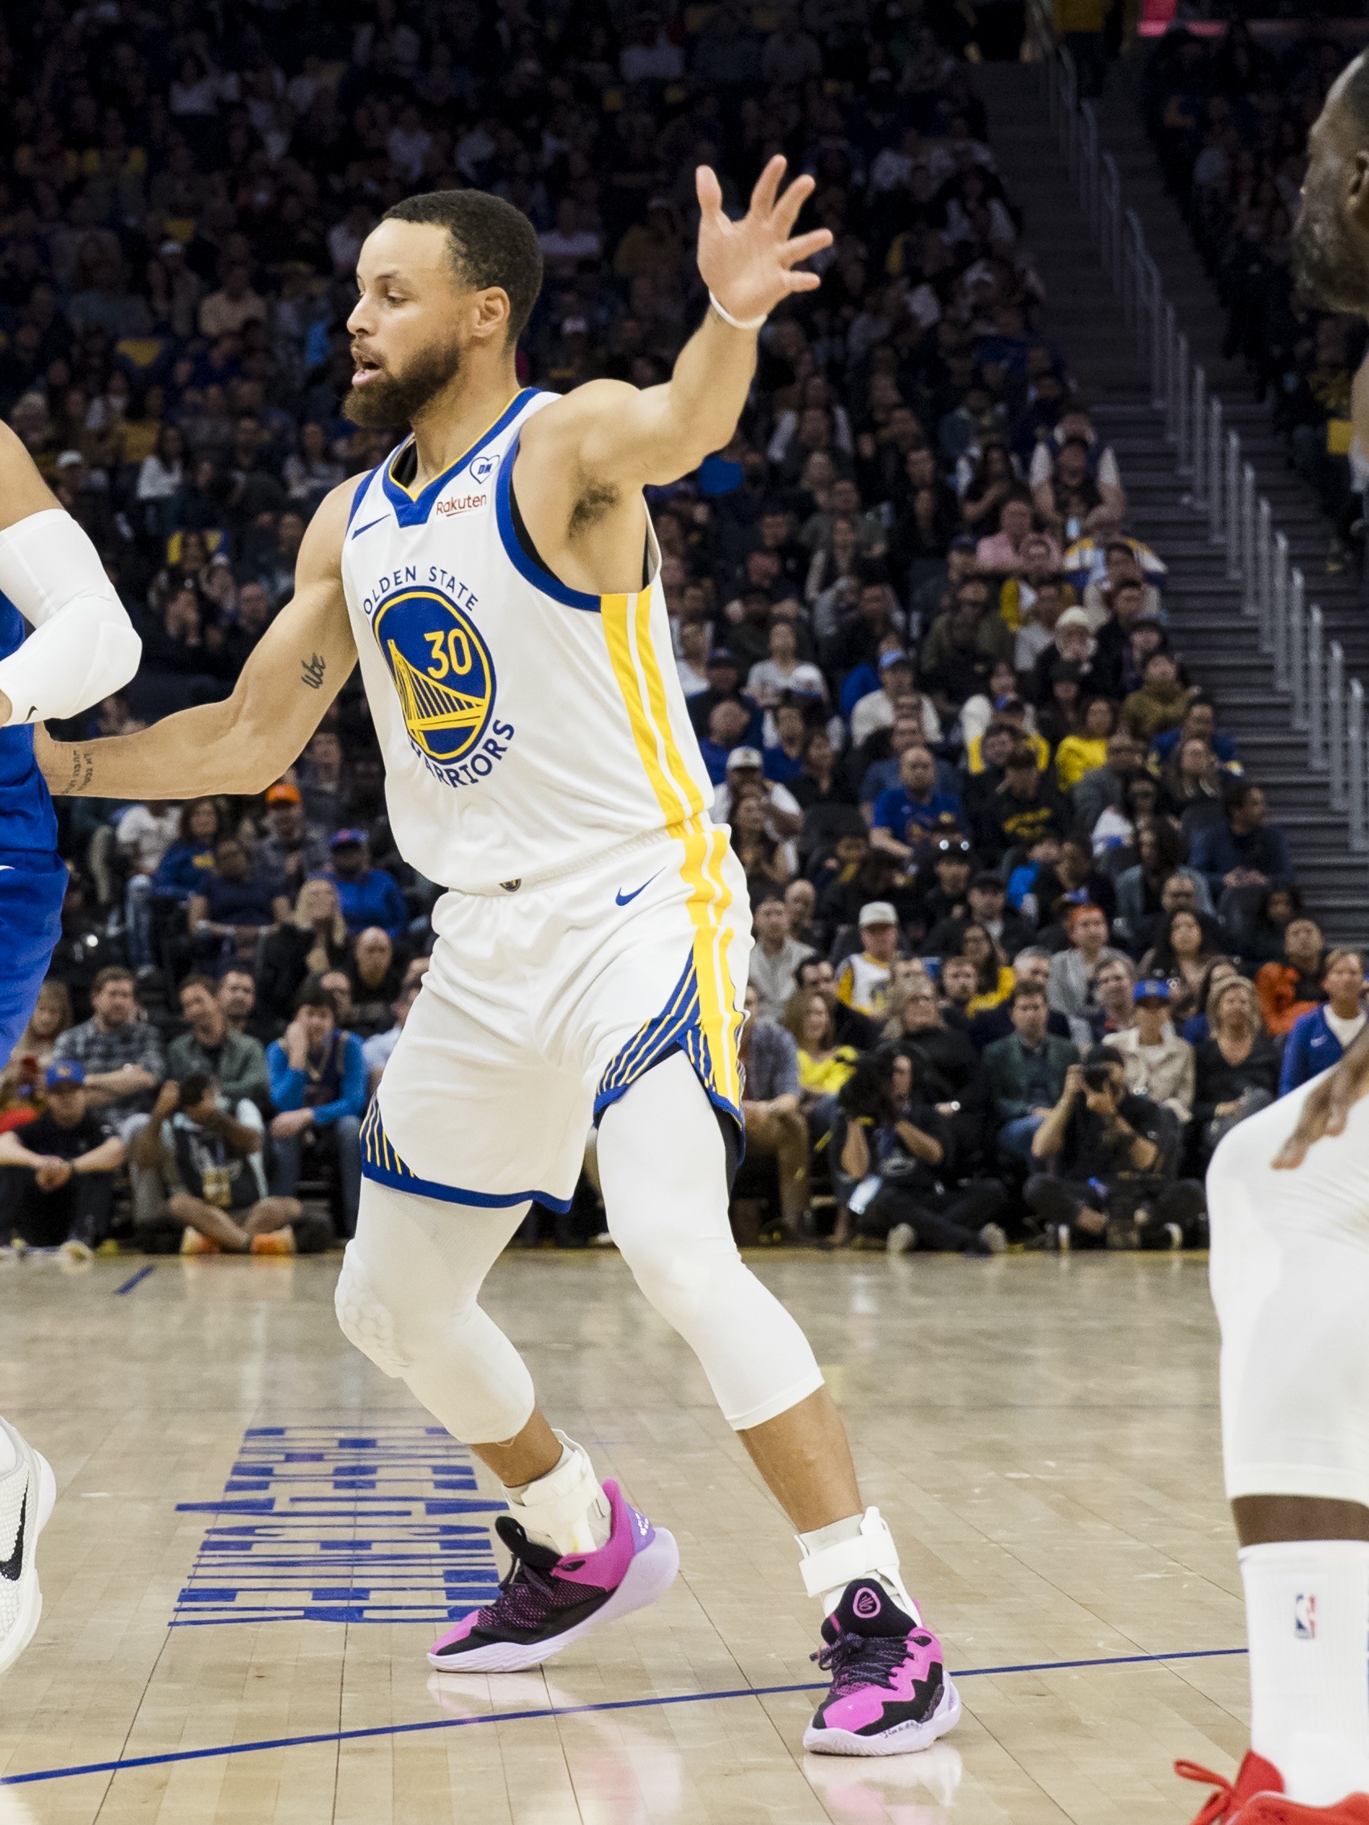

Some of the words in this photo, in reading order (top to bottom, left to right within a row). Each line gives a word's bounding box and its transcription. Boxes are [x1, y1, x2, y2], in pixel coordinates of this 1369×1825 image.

[436, 494, 487, 516] Rakuten
[363, 565, 417, 615] OLDEN
[428, 566, 479, 612] STATE
[423, 628, 472, 679] 30
[167, 1523, 504, 1627] CENTER
